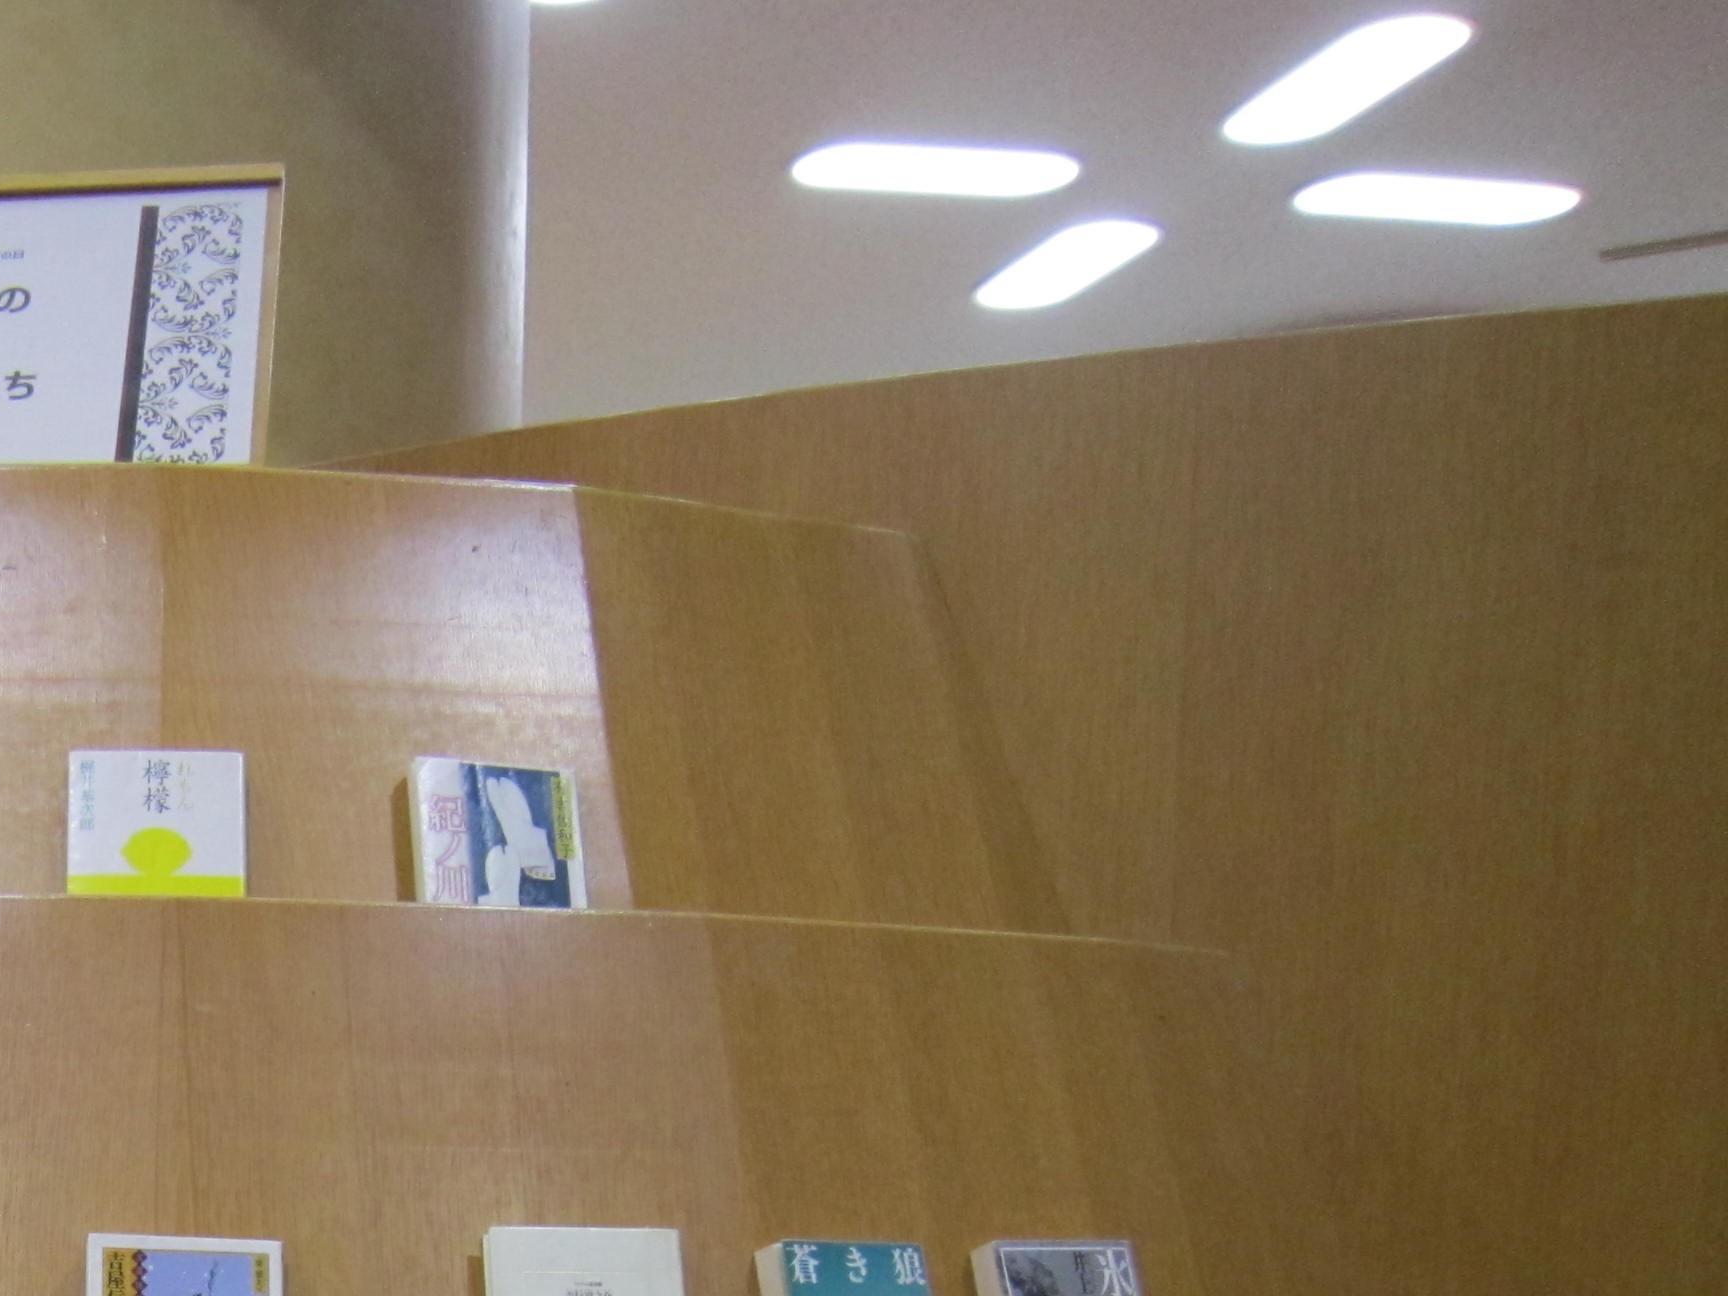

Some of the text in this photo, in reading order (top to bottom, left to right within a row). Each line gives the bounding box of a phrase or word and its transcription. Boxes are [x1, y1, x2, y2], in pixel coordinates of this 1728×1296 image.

[143, 760, 171, 814] 檸檬
[427, 795, 470, 907] 紀ノ川
[786, 1244, 927, 1286] 蒼き狼
